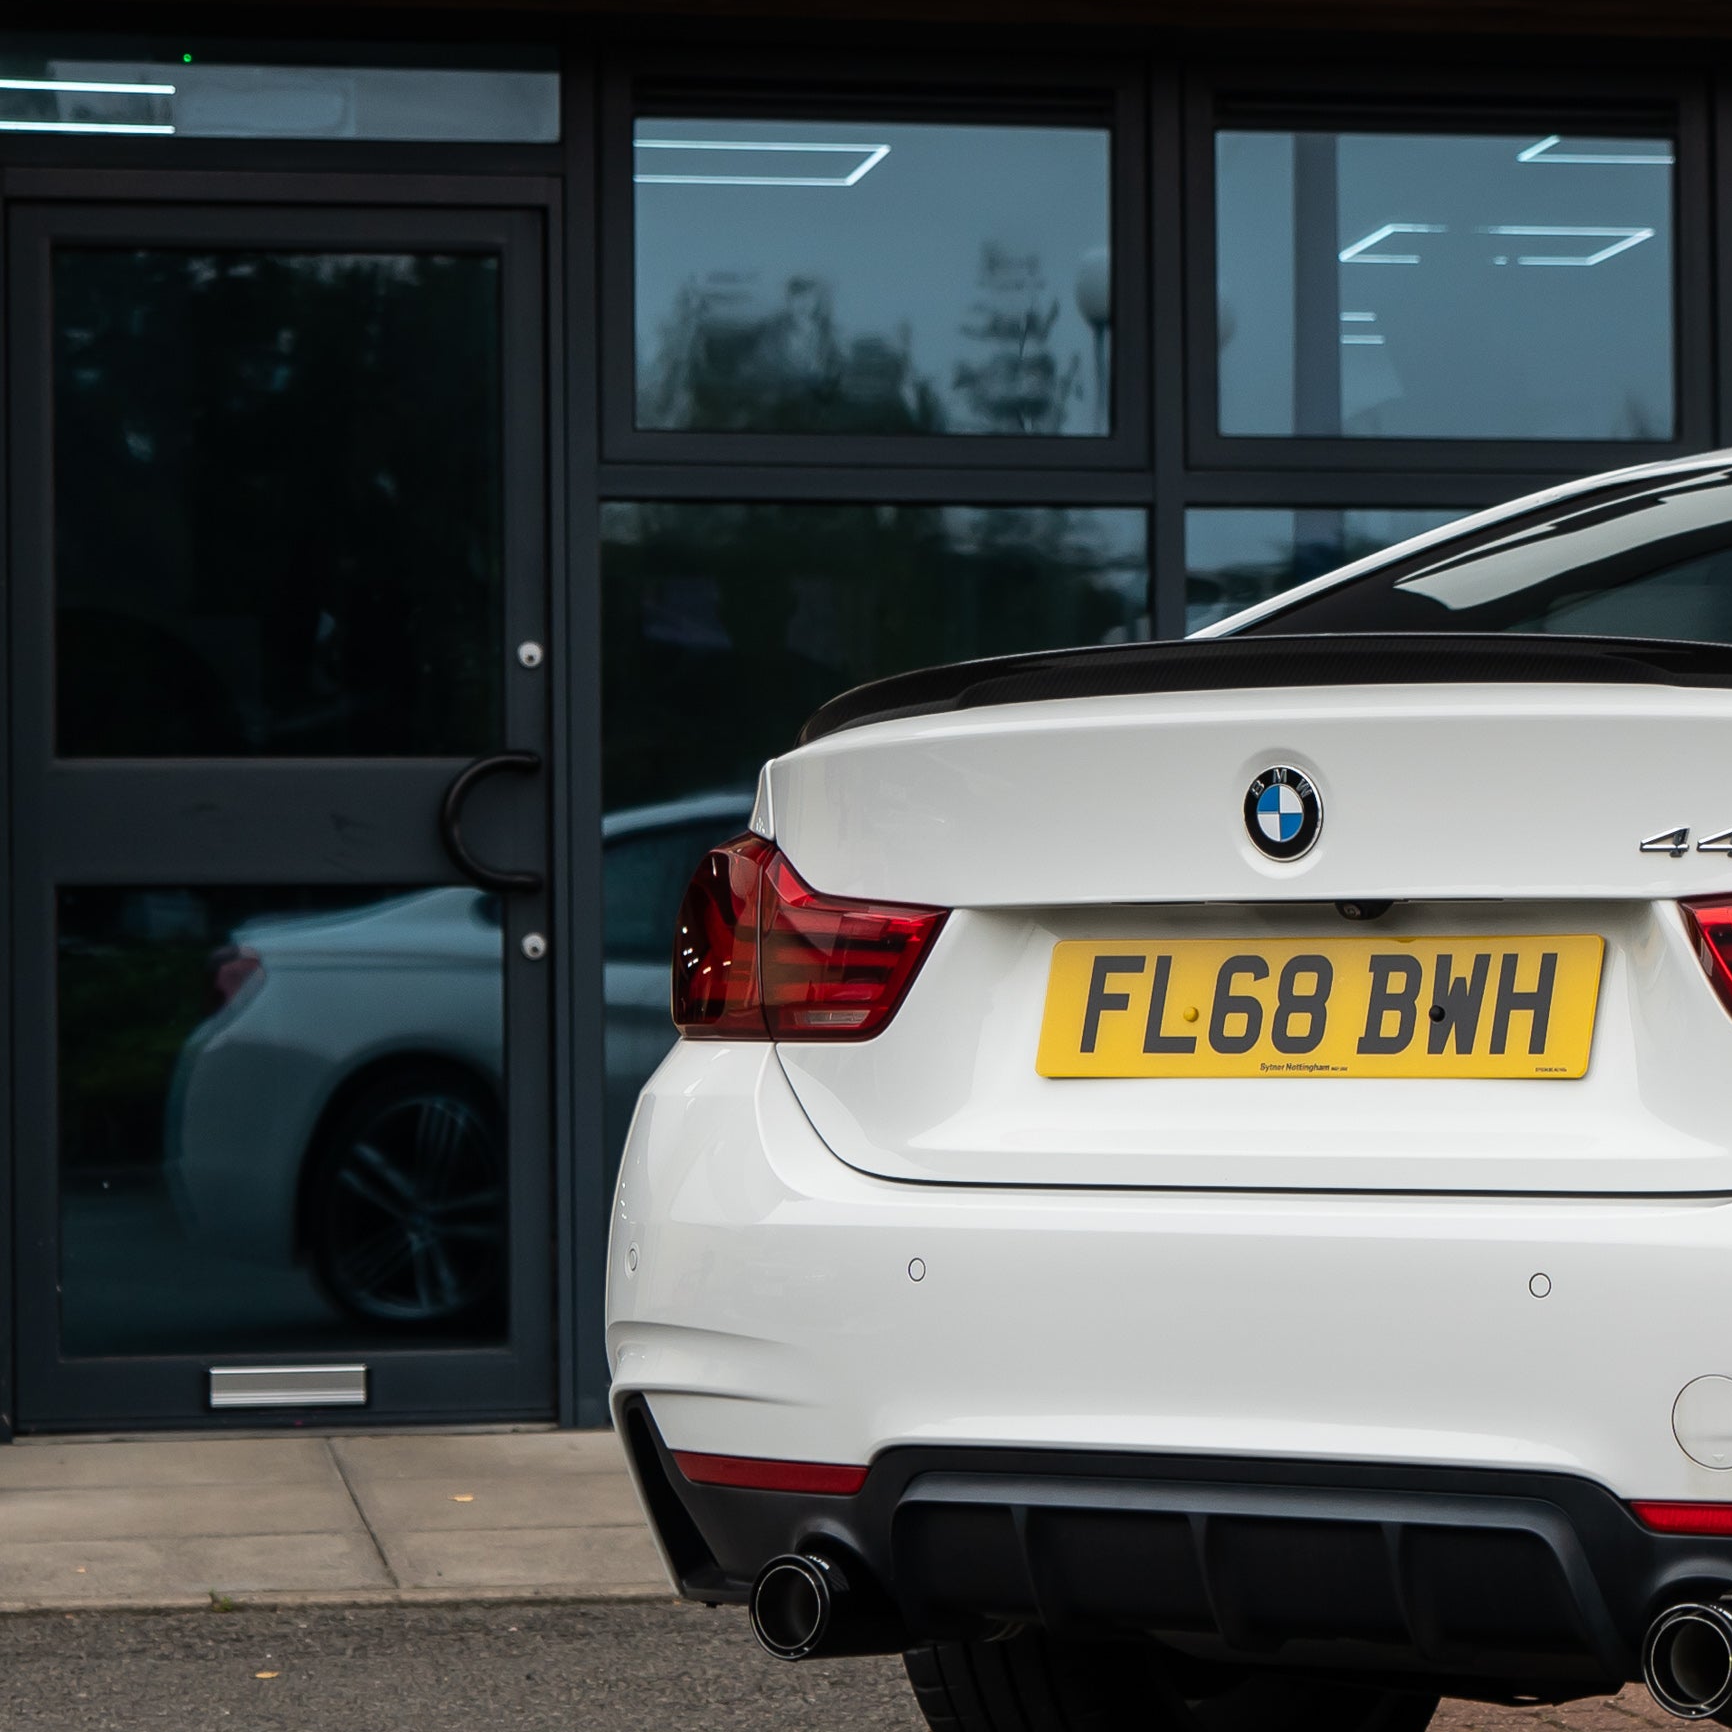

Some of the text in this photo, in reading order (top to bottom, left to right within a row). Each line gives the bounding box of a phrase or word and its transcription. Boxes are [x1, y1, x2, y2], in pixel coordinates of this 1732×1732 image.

[1249, 767, 1314, 799] BMW
[1078, 952, 1560, 1056] FL68 BWH
[1286, 1062, 1331, 1073] Nottingham
